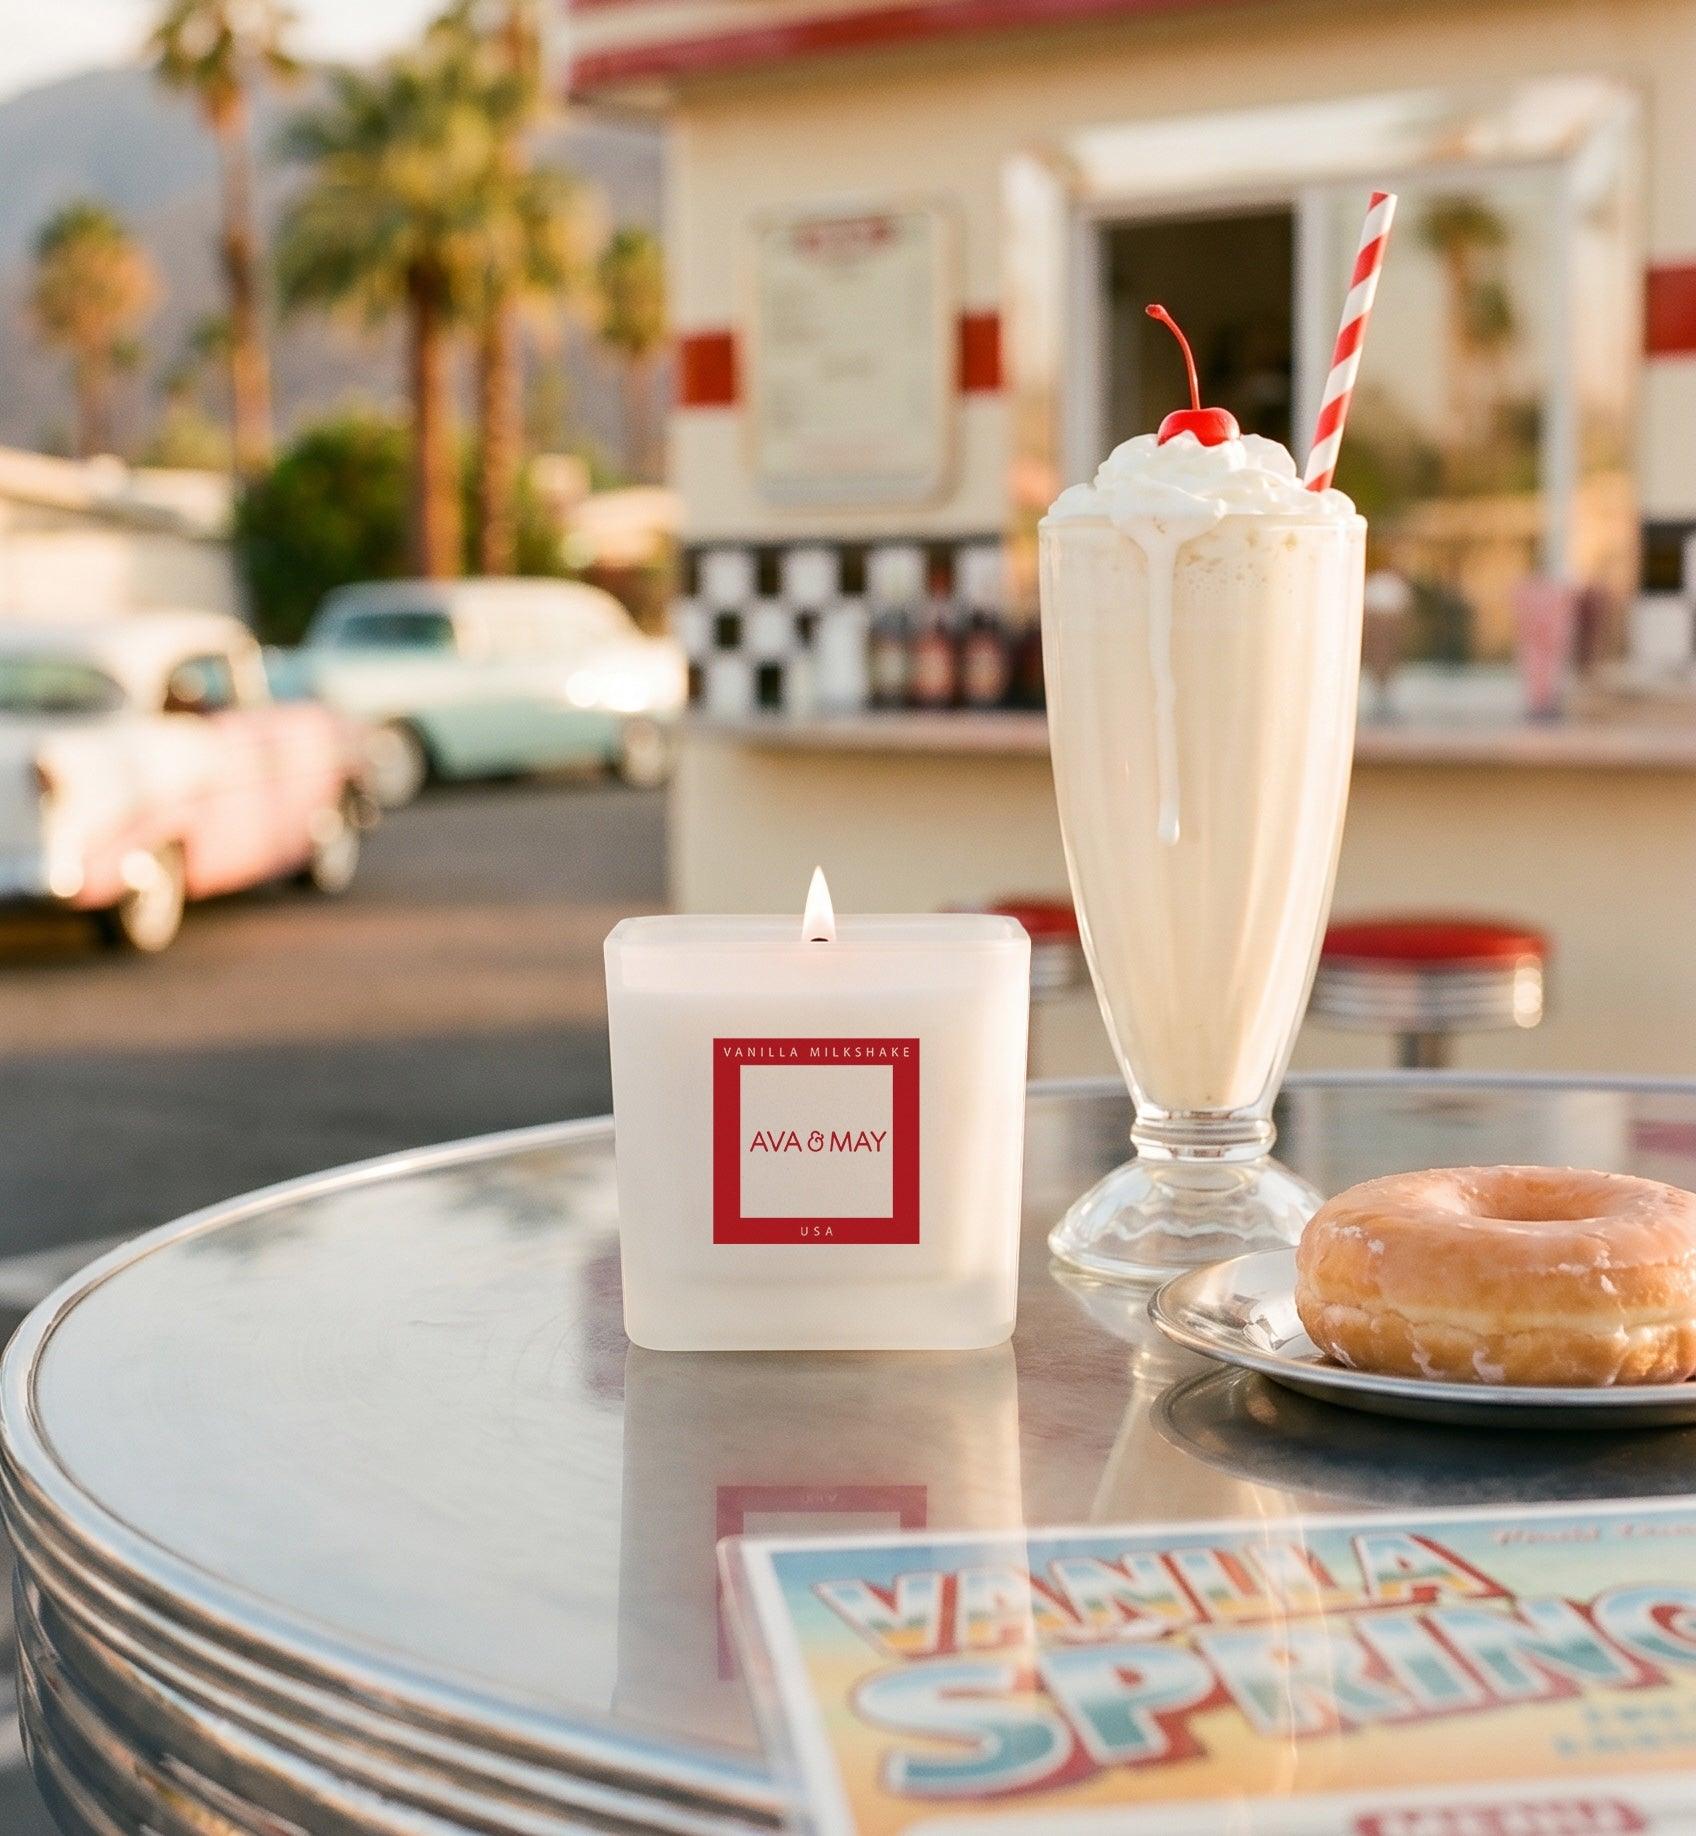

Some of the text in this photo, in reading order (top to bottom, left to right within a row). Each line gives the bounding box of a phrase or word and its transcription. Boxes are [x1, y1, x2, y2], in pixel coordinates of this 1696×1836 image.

[723, 1046, 911, 1058] VANILLA MILKSHAKE
[800, 1226, 834, 1237] USA
